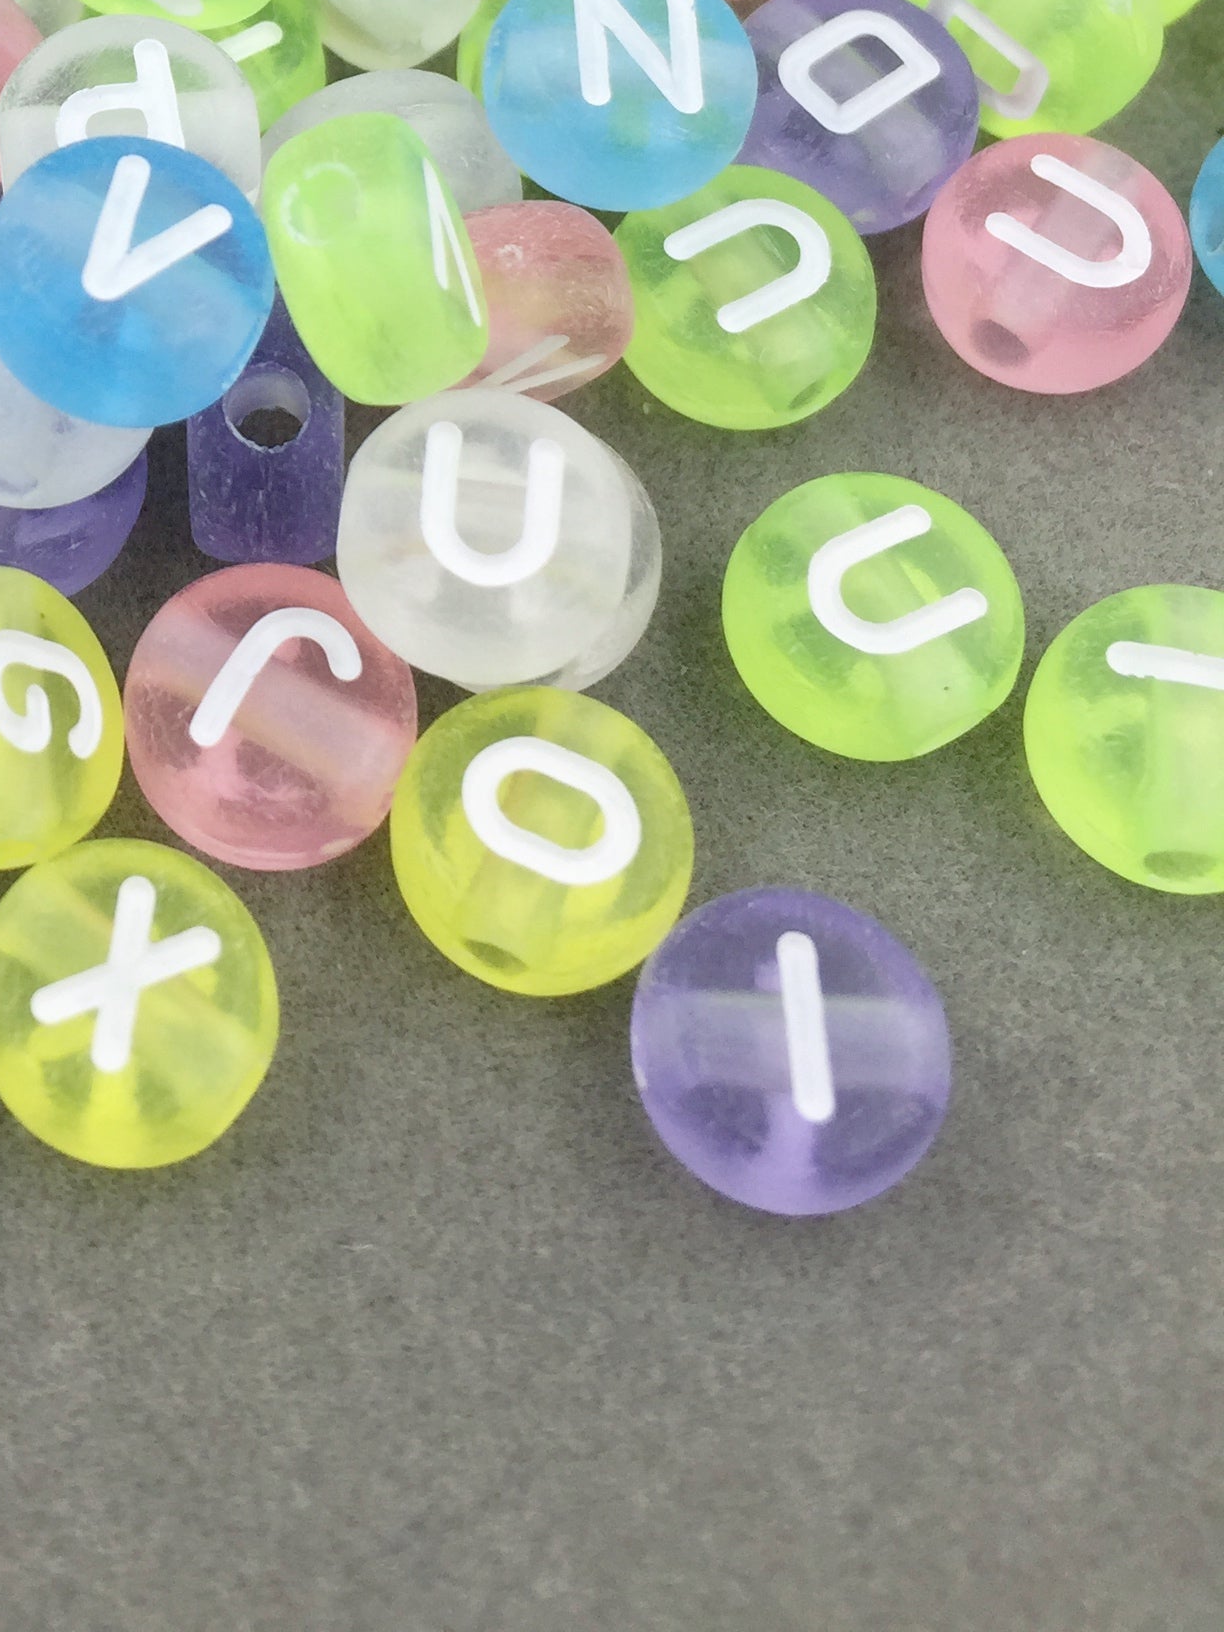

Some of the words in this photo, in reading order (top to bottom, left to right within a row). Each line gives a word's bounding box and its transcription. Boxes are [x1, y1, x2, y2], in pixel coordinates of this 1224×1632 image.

[779, 11, 940, 133] D
[85, 158, 230, 299] V
[664, 200, 831, 332] U
[985, 155, 1151, 287] U
[418, 418, 566, 588] U
[808, 506, 987, 654] U
[190, 608, 361, 747] J
[463, 738, 639, 884] O
[32, 877, 219, 1071] X
